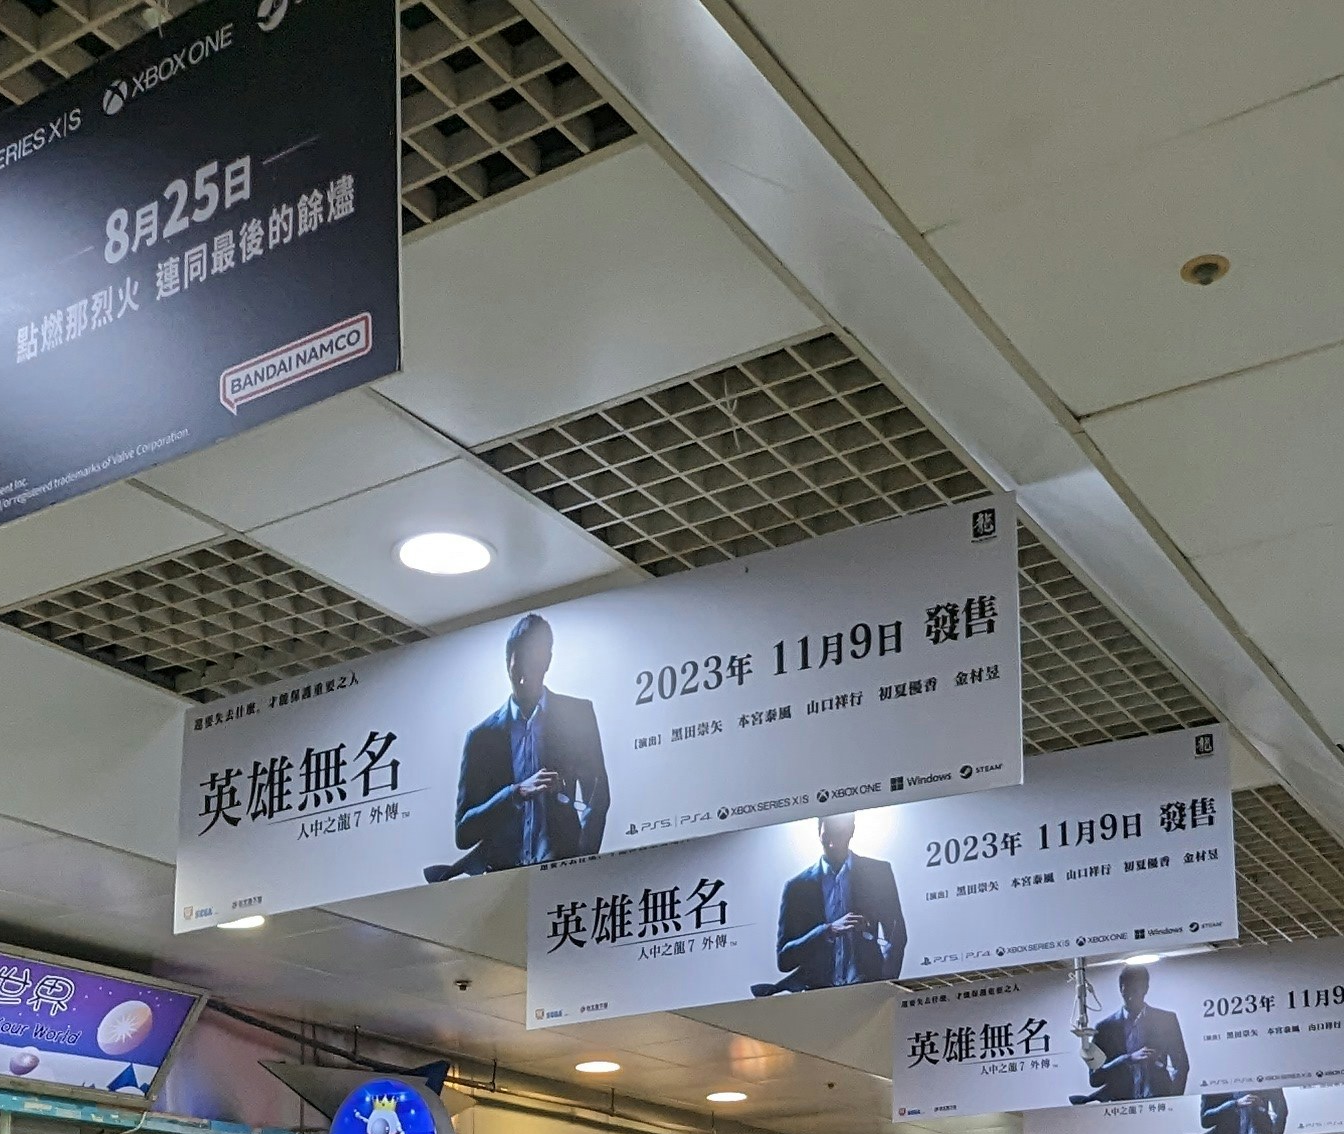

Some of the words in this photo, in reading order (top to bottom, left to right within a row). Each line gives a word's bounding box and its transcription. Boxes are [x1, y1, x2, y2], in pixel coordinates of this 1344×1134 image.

[131, 48, 187, 98] XBOX
[188, 22, 233, 65] ONE
[103, 155, 251, 264] 8月25日
[16, 276, 140, 363] 點燃那烈火
[156, 174, 355, 301] 連同最後的餘燼
[231, 357, 293, 397] BANDAI
[295, 328, 361, 371] NAMCO
[52, 461, 102, 489] trademarks
[135, 427, 190, 456] Corporation.
[635, 652, 753, 706] 2023年
[773, 620, 903, 676] 11月9日
[924, 595, 998, 646] 發售
[737, 705, 793, 729] 本宮泰風
[806, 690, 864, 716] 山口祥行
[198, 731, 400, 837] 英雄無名
[730, 801, 757, 817] XBOX
[757, 797, 790, 812] SERIES
[830, 786, 860, 800] XBOX
[860, 782, 882, 796] ONE
[906, 771, 952, 788] Windows
[975, 763, 1003, 774] STEAM
[926, 832, 1022, 868] 2023年
[1039, 813, 1142, 851] 11月9日
[1159, 797, 1216, 833] 發售
[547, 878, 728, 954] 英雄無名
[1147, 925, 1183, 938] Windows
[32, 1023, 82, 1047] World
[1203, 994, 1276, 1018] 2023年
[907, 1017, 1051, 1069] 英雄無名
